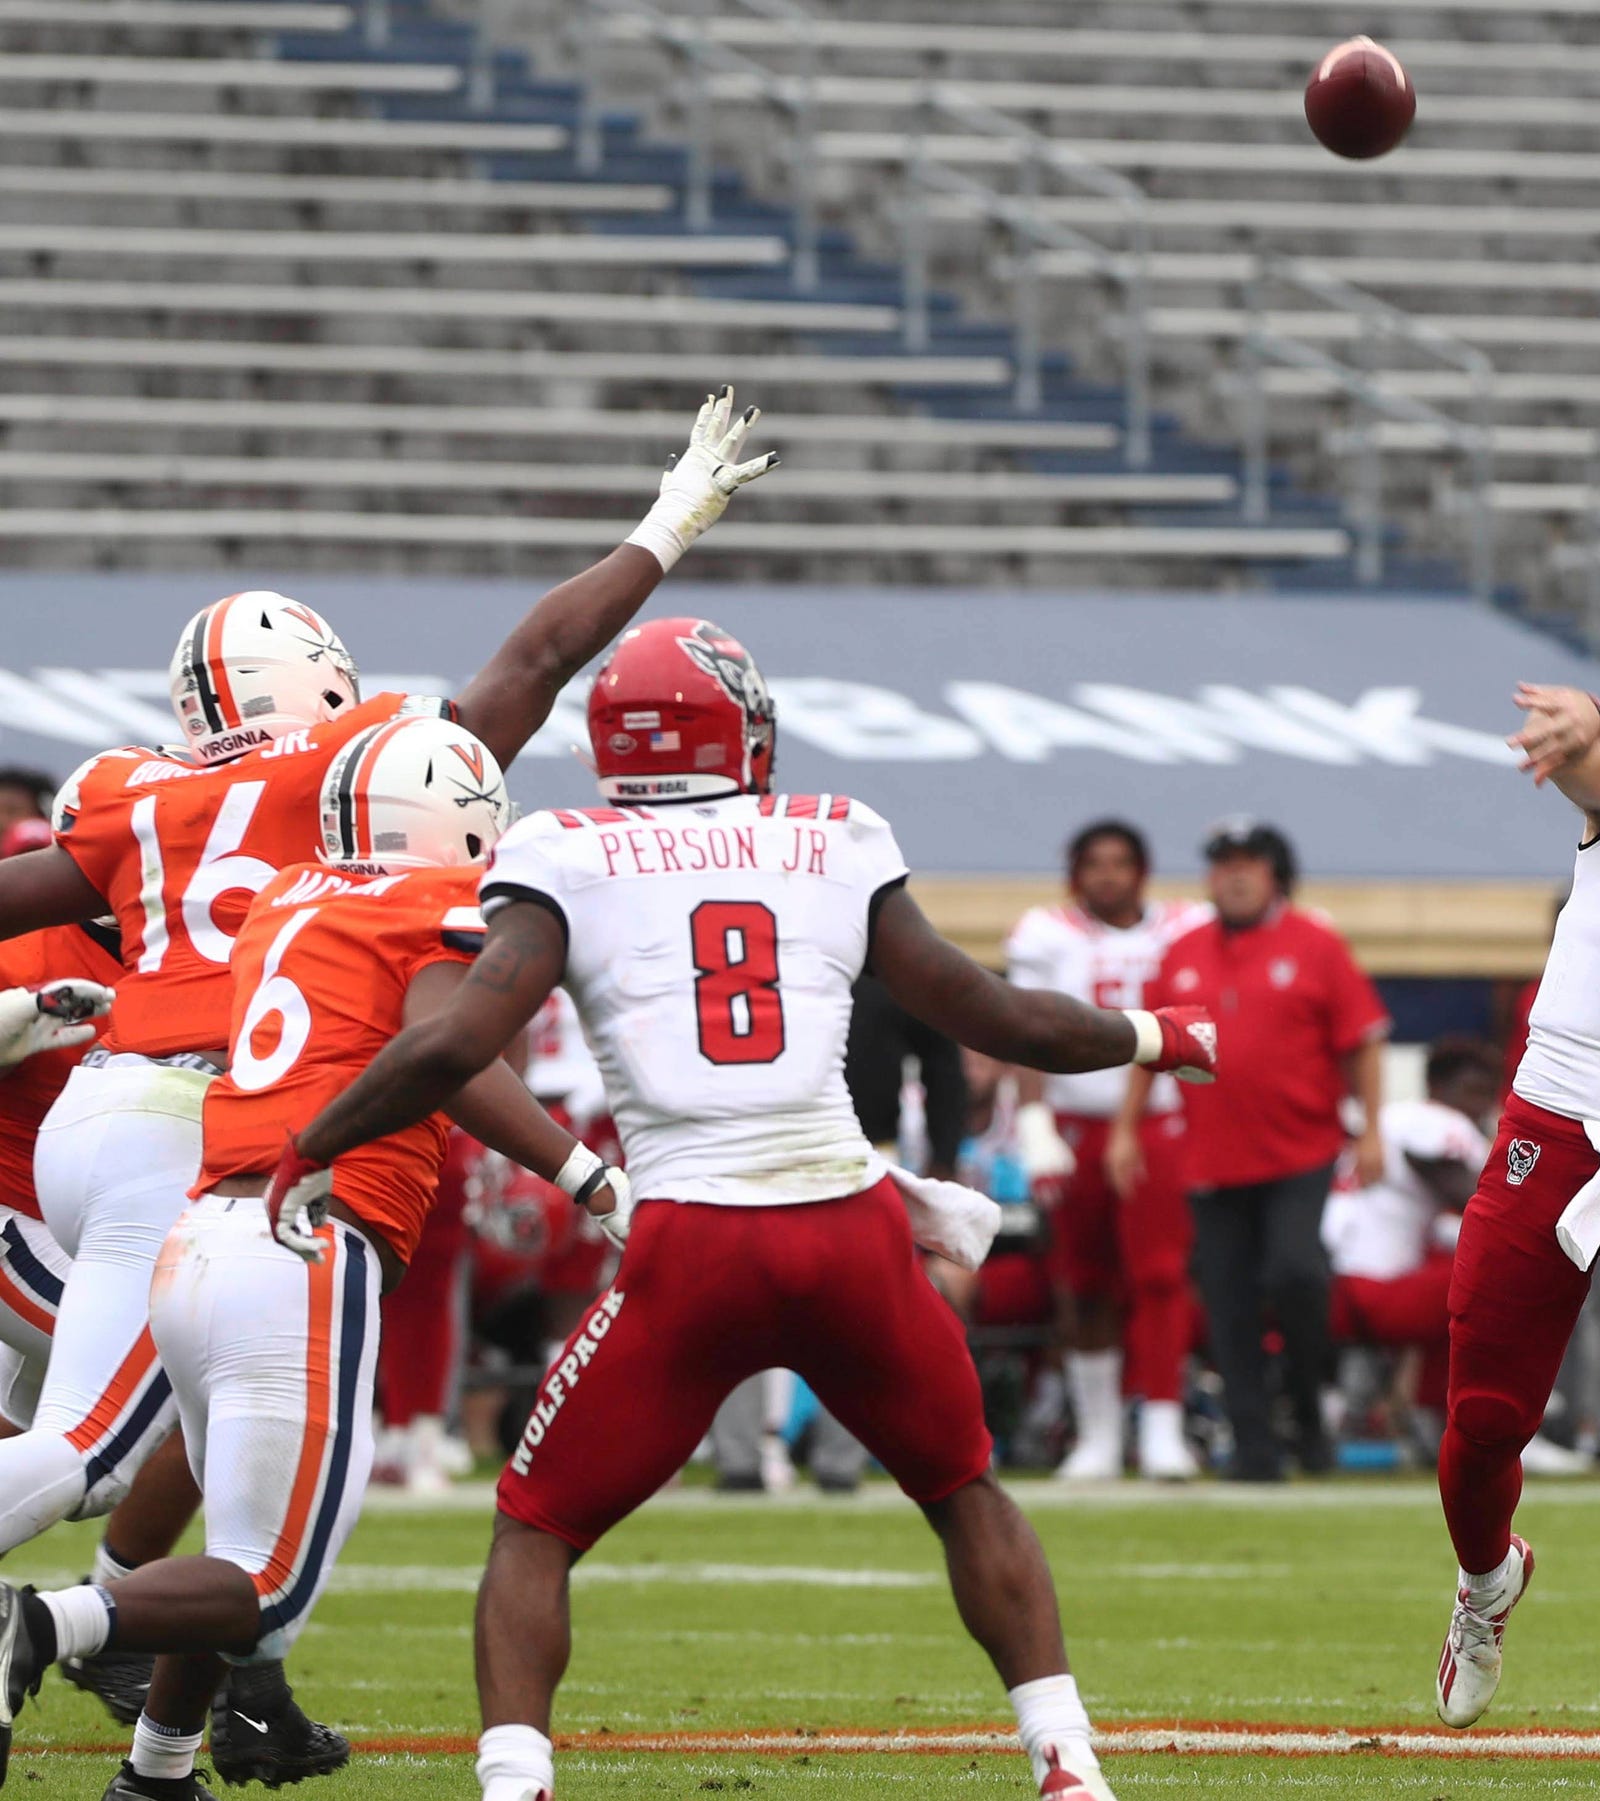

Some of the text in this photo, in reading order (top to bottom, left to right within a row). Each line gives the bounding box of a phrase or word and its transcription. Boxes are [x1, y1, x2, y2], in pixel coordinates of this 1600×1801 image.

[199, 728, 274, 760] VIRGINIA
[260, 727, 319, 759] JR.
[130, 779, 280, 974] 16
[599, 826, 827, 877] PERSON JR
[230, 907, 312, 1091] 6
[690, 900, 786, 1065] 8
[511, 1286, 625, 1476] WOLFPACK
